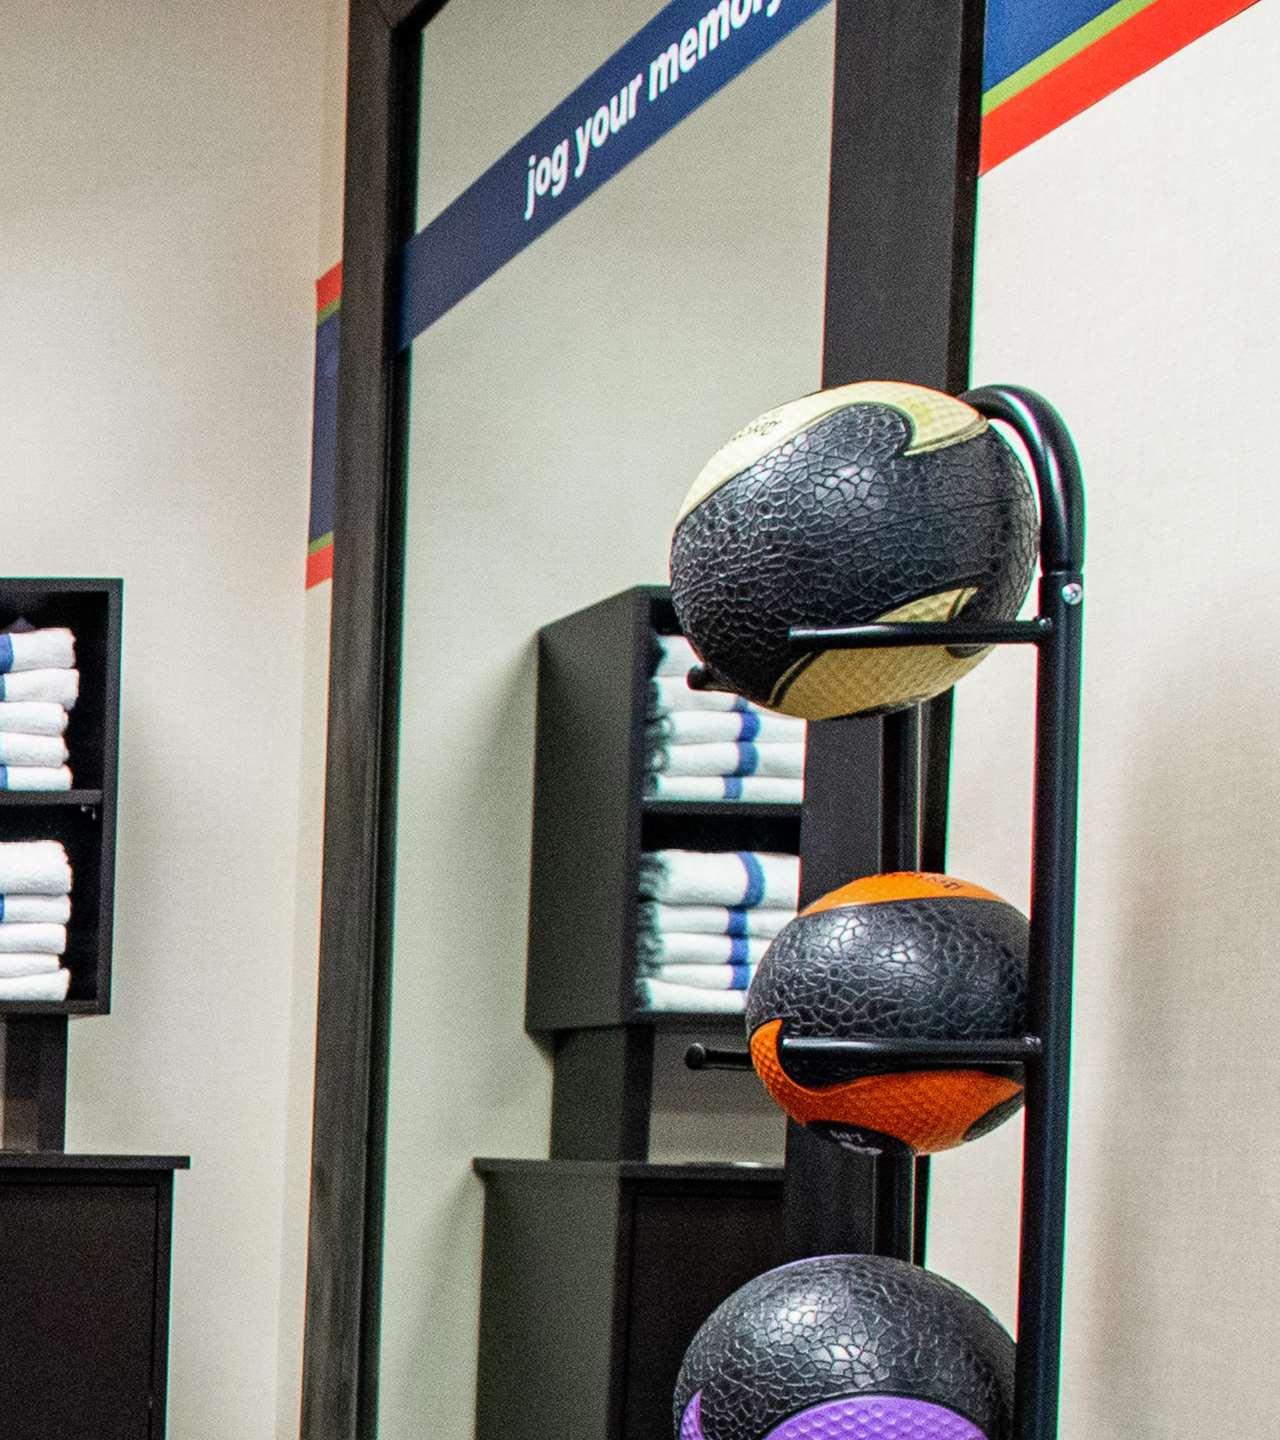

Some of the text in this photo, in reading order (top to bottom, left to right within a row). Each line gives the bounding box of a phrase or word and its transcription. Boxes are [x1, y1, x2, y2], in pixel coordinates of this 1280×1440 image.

[524, 0, 781, 221] jog your memo
